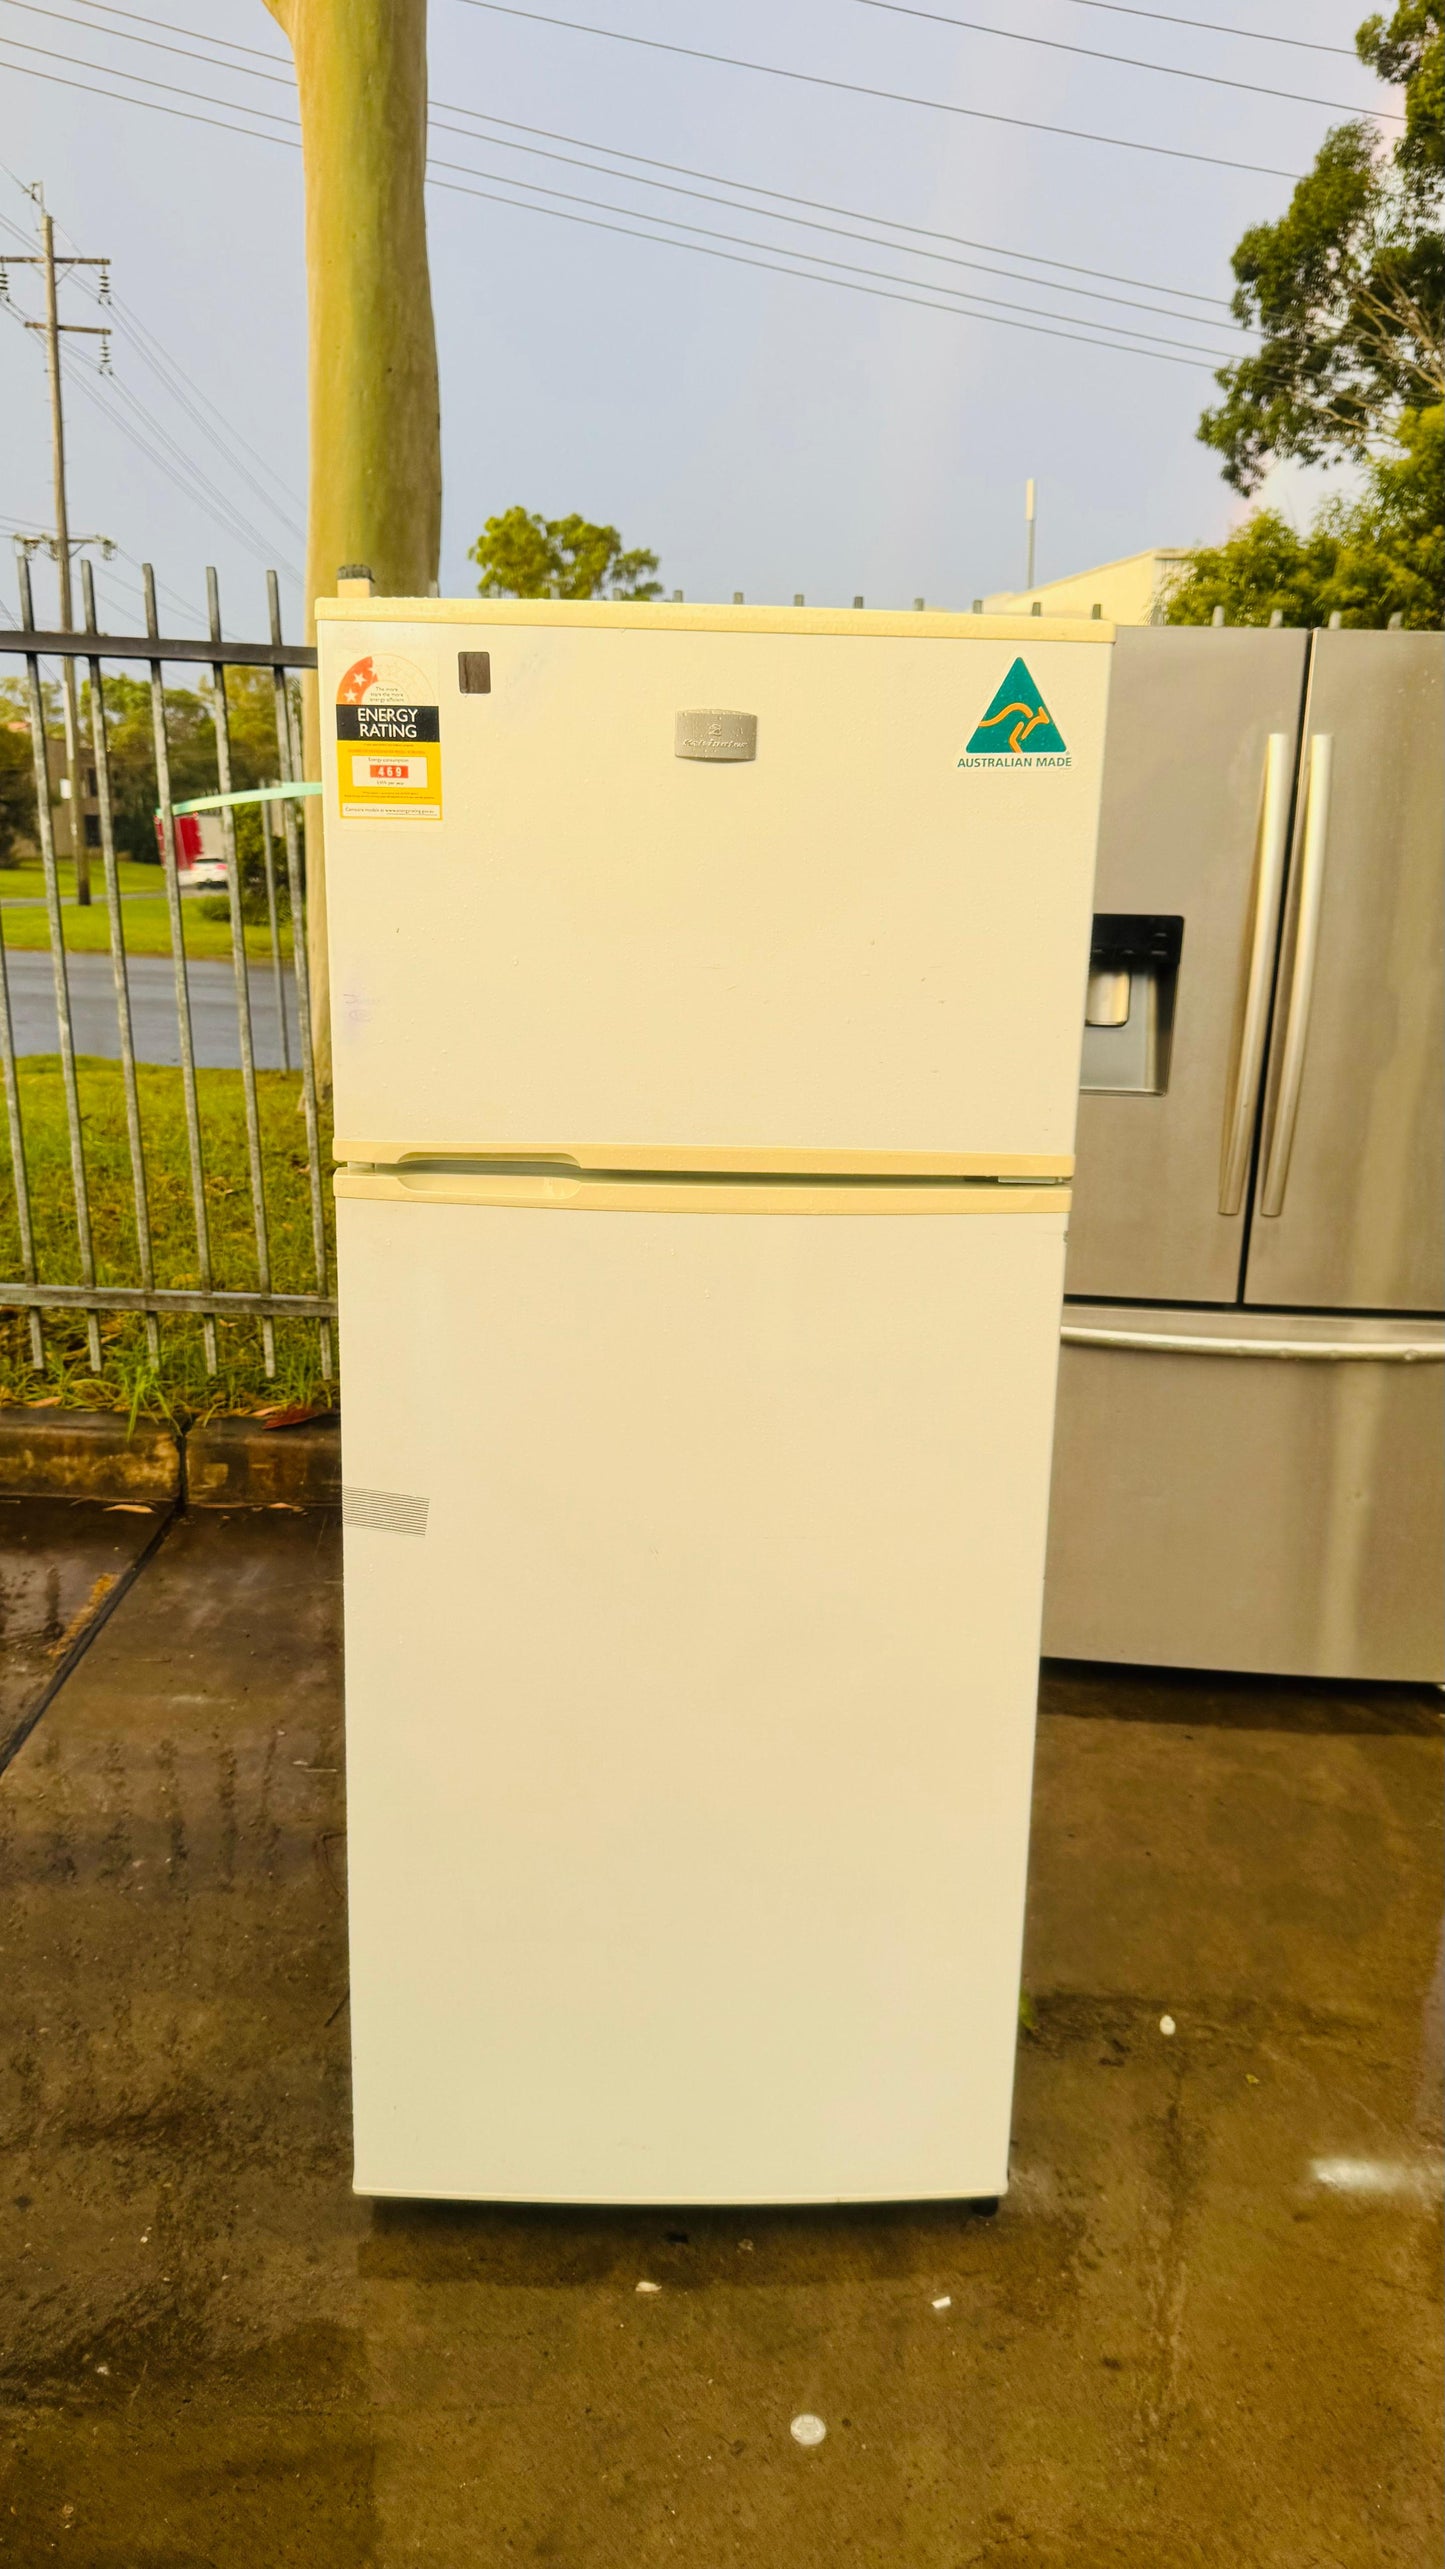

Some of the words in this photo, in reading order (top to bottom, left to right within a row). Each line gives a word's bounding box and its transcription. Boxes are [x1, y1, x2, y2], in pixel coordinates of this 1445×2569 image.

[357, 708, 418, 722] ENERGY
[360, 723, 417, 738] RATING
[957, 758, 1032, 768] AUSTRALIAN
[1036, 757, 1072, 767] MADE
[378, 766, 402, 777] 469
